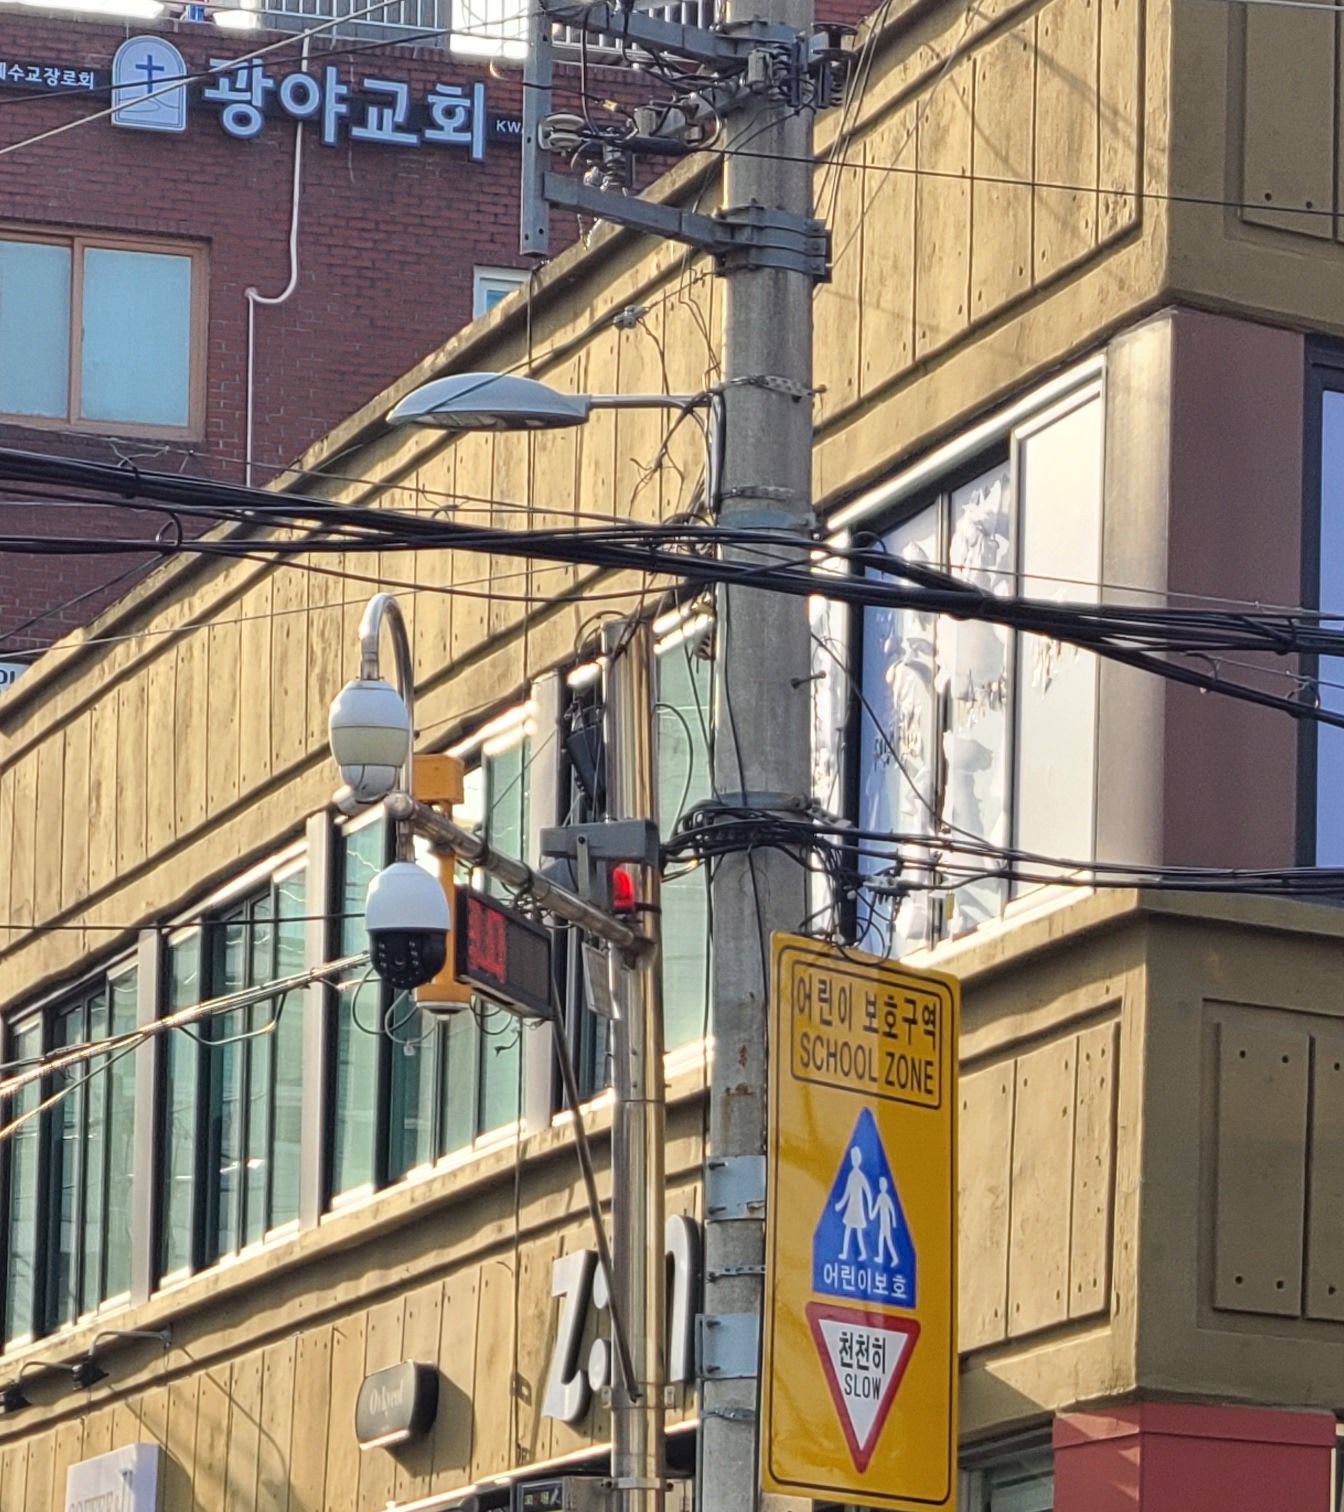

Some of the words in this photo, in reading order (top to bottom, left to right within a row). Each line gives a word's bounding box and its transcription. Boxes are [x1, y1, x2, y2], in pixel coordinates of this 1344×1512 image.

[204, 59, 487, 162] 광야교회
[796, 972, 852, 1029] 어린이
[862, 990, 937, 1052] 보호구역
[799, 1031, 878, 1084] SCHOOL
[885, 1049, 936, 1096] ZONE
[823, 1263, 908, 1300] 어린이보호
[838, 1330, 888, 1376] 천천히
[843, 1373, 882, 1401] SLOW
